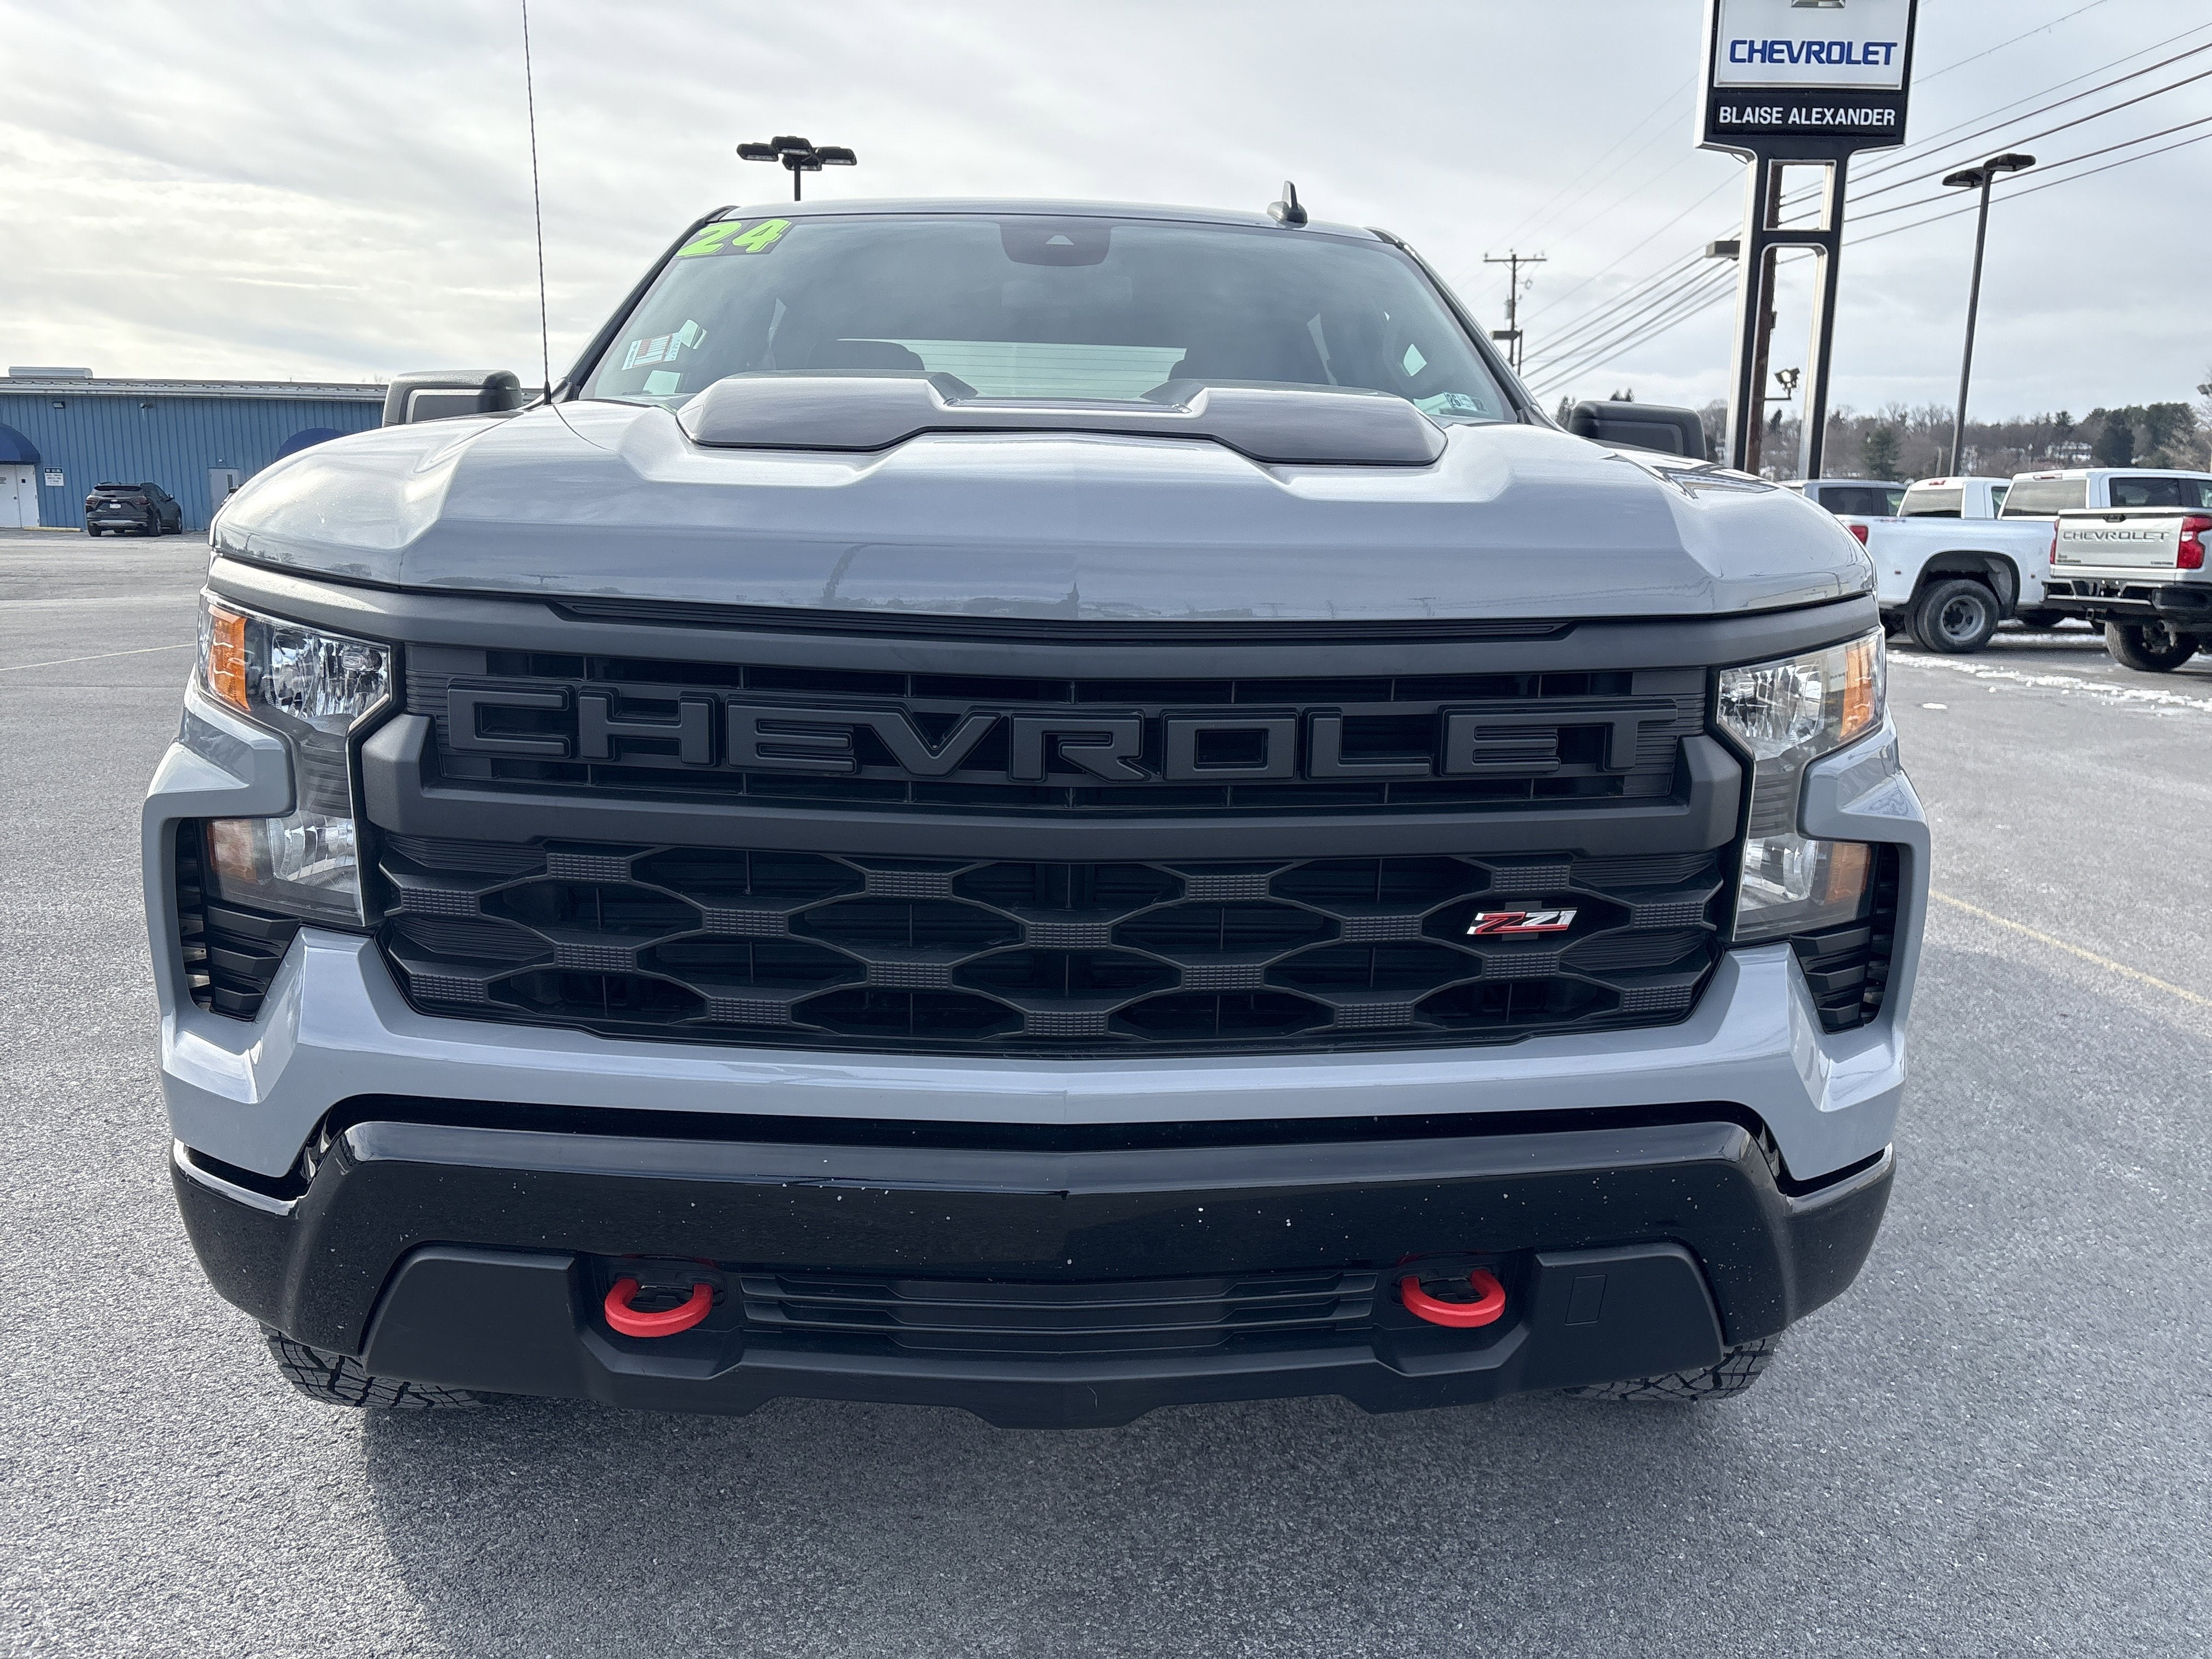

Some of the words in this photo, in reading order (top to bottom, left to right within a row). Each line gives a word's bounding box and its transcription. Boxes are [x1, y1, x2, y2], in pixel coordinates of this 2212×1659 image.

[1730, 40, 1898, 65] CHEVROLET
[1719, 106, 1784, 125] BLAISE
[1788, 108, 1895, 126] ALEXANDER
[676, 219, 792, 257] 24
[2063, 531, 2170, 543] CHEVROLET
[447, 676, 1678, 783] CHEVROLET
[1466, 910, 1577, 935] Z71
